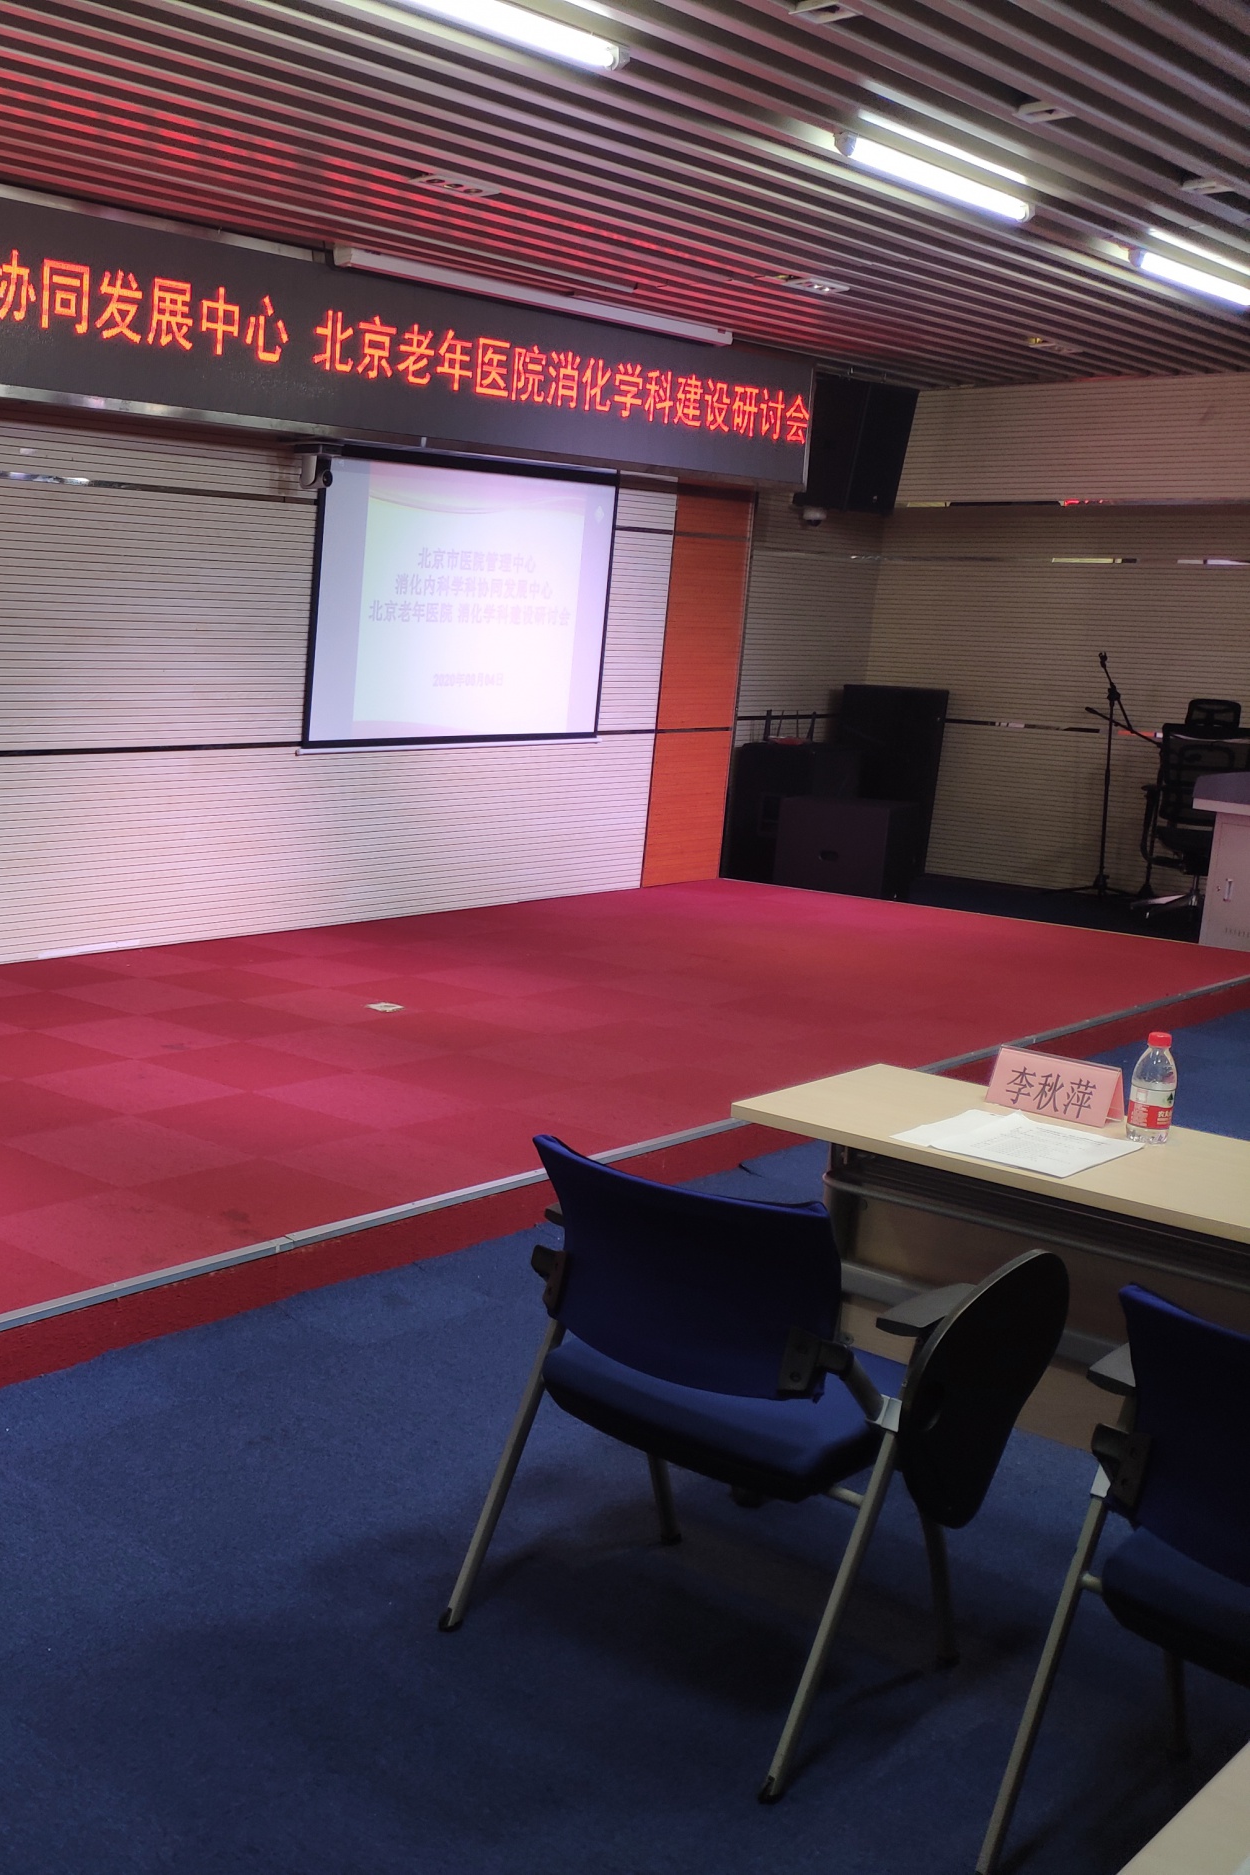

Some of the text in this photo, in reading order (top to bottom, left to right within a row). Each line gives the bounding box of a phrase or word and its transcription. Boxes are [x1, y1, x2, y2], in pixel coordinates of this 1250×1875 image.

[313, 309, 810, 445] 北京老年医院消化学科建设研讨会
[418, 546, 536, 574] 北京市医院管理中心
[394, 573, 553, 600] 消化内科学科协同发展中心
[368, 600, 454, 623] 北京老年医院
[1005, 1065, 1097, 1119] 李秋萍
